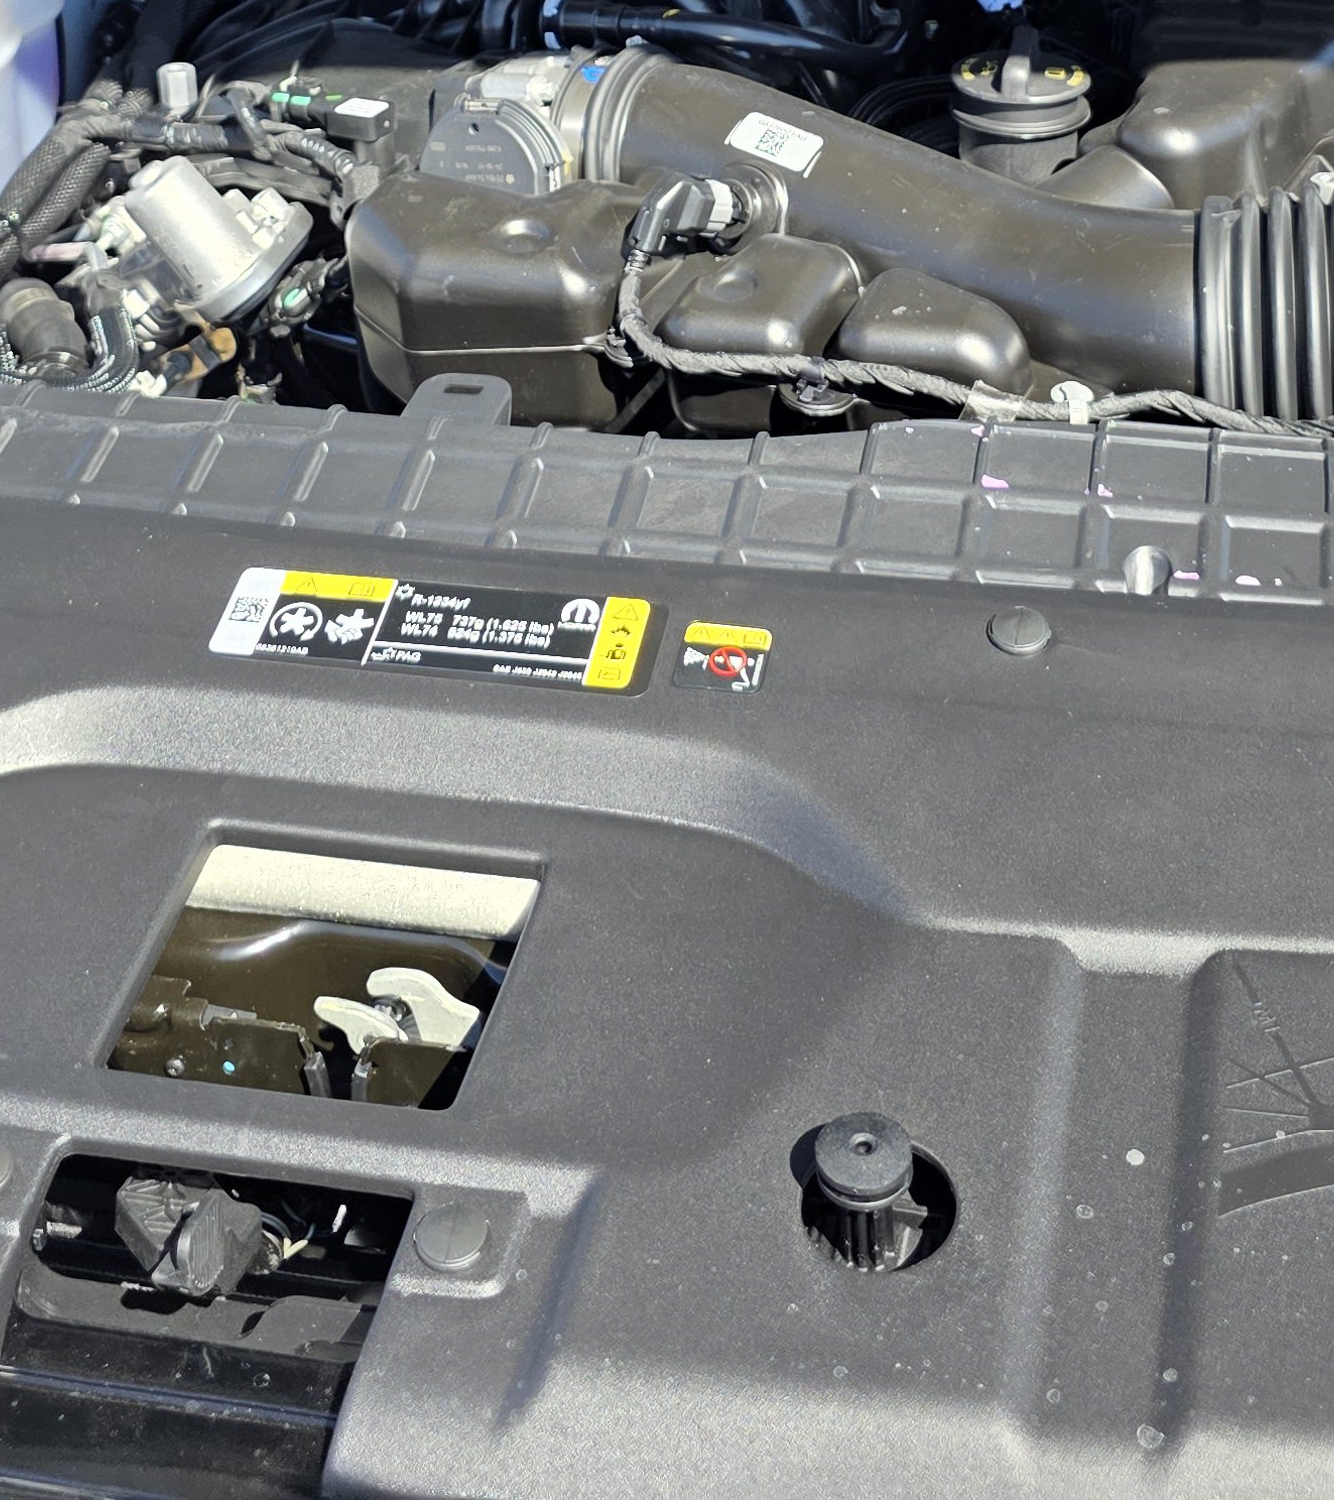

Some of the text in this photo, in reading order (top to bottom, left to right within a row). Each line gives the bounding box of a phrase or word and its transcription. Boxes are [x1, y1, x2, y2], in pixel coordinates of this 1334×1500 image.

[406, 610, 443, 625] WL75
[452, 615, 484, 630] 737g
[401, 623, 438, 637] WL74
[395, 650, 422, 663] PAG
